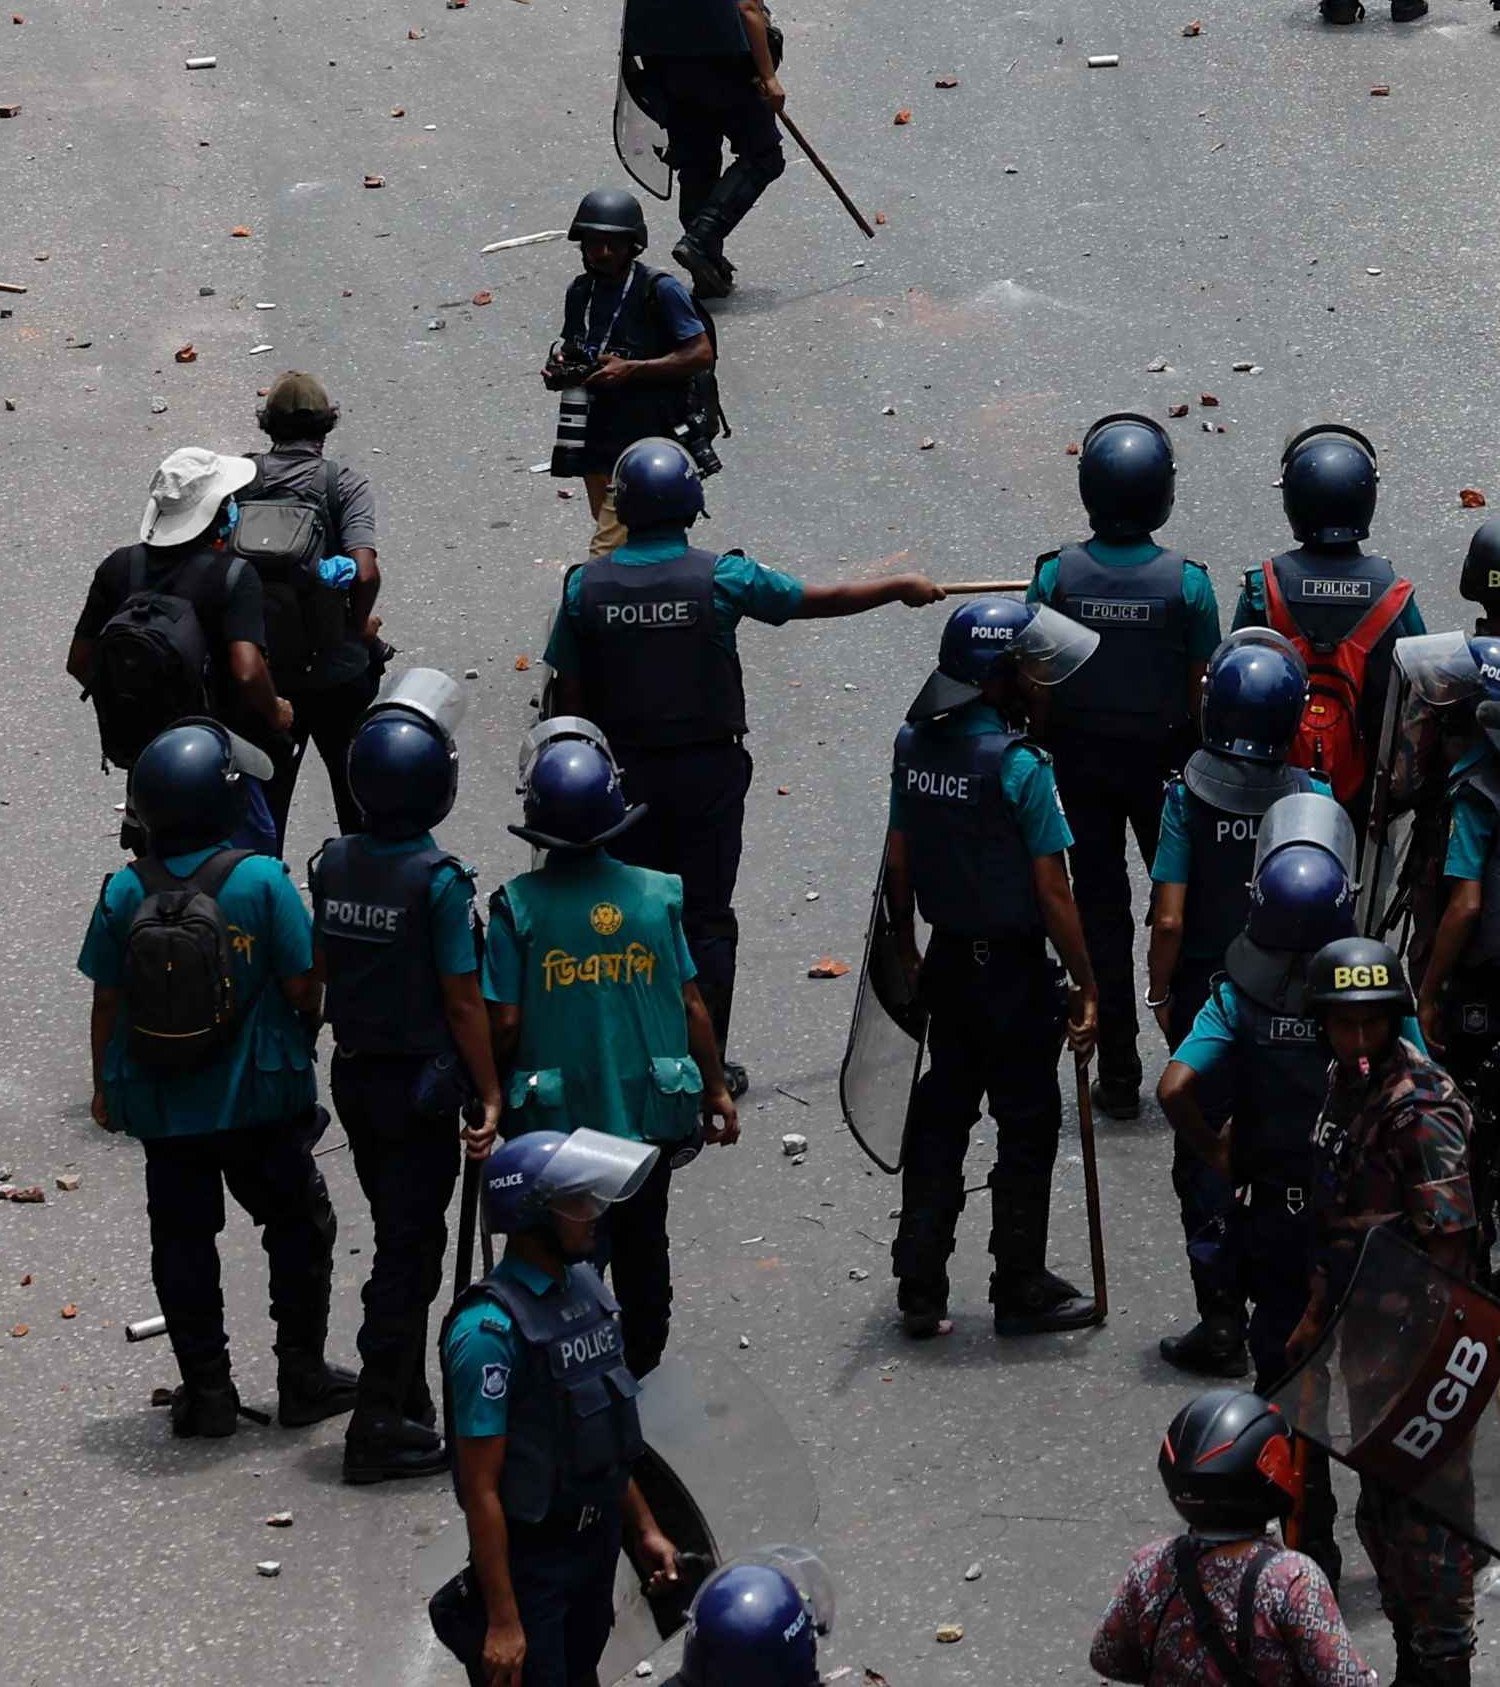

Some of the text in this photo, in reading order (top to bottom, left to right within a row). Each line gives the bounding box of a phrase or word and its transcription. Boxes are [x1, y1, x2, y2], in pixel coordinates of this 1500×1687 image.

[1314, 583, 1361, 597] POLICE
[606, 600, 690, 625] POLICE
[1092, 605, 1139, 619] POLICE
[970, 625, 1013, 640] POLICE
[907, 769, 969, 800] POLICE
[1216, 820, 1260, 842] POL
[324, 900, 398, 932] POLICE
[542, 942, 659, 993] ডিএমপি
[1334, 964, 1390, 989] BGB
[489, 1172, 524, 1189] POLICE
[560, 1325, 617, 1368] POLICE
[1391, 1334, 1489, 1461] BGB
